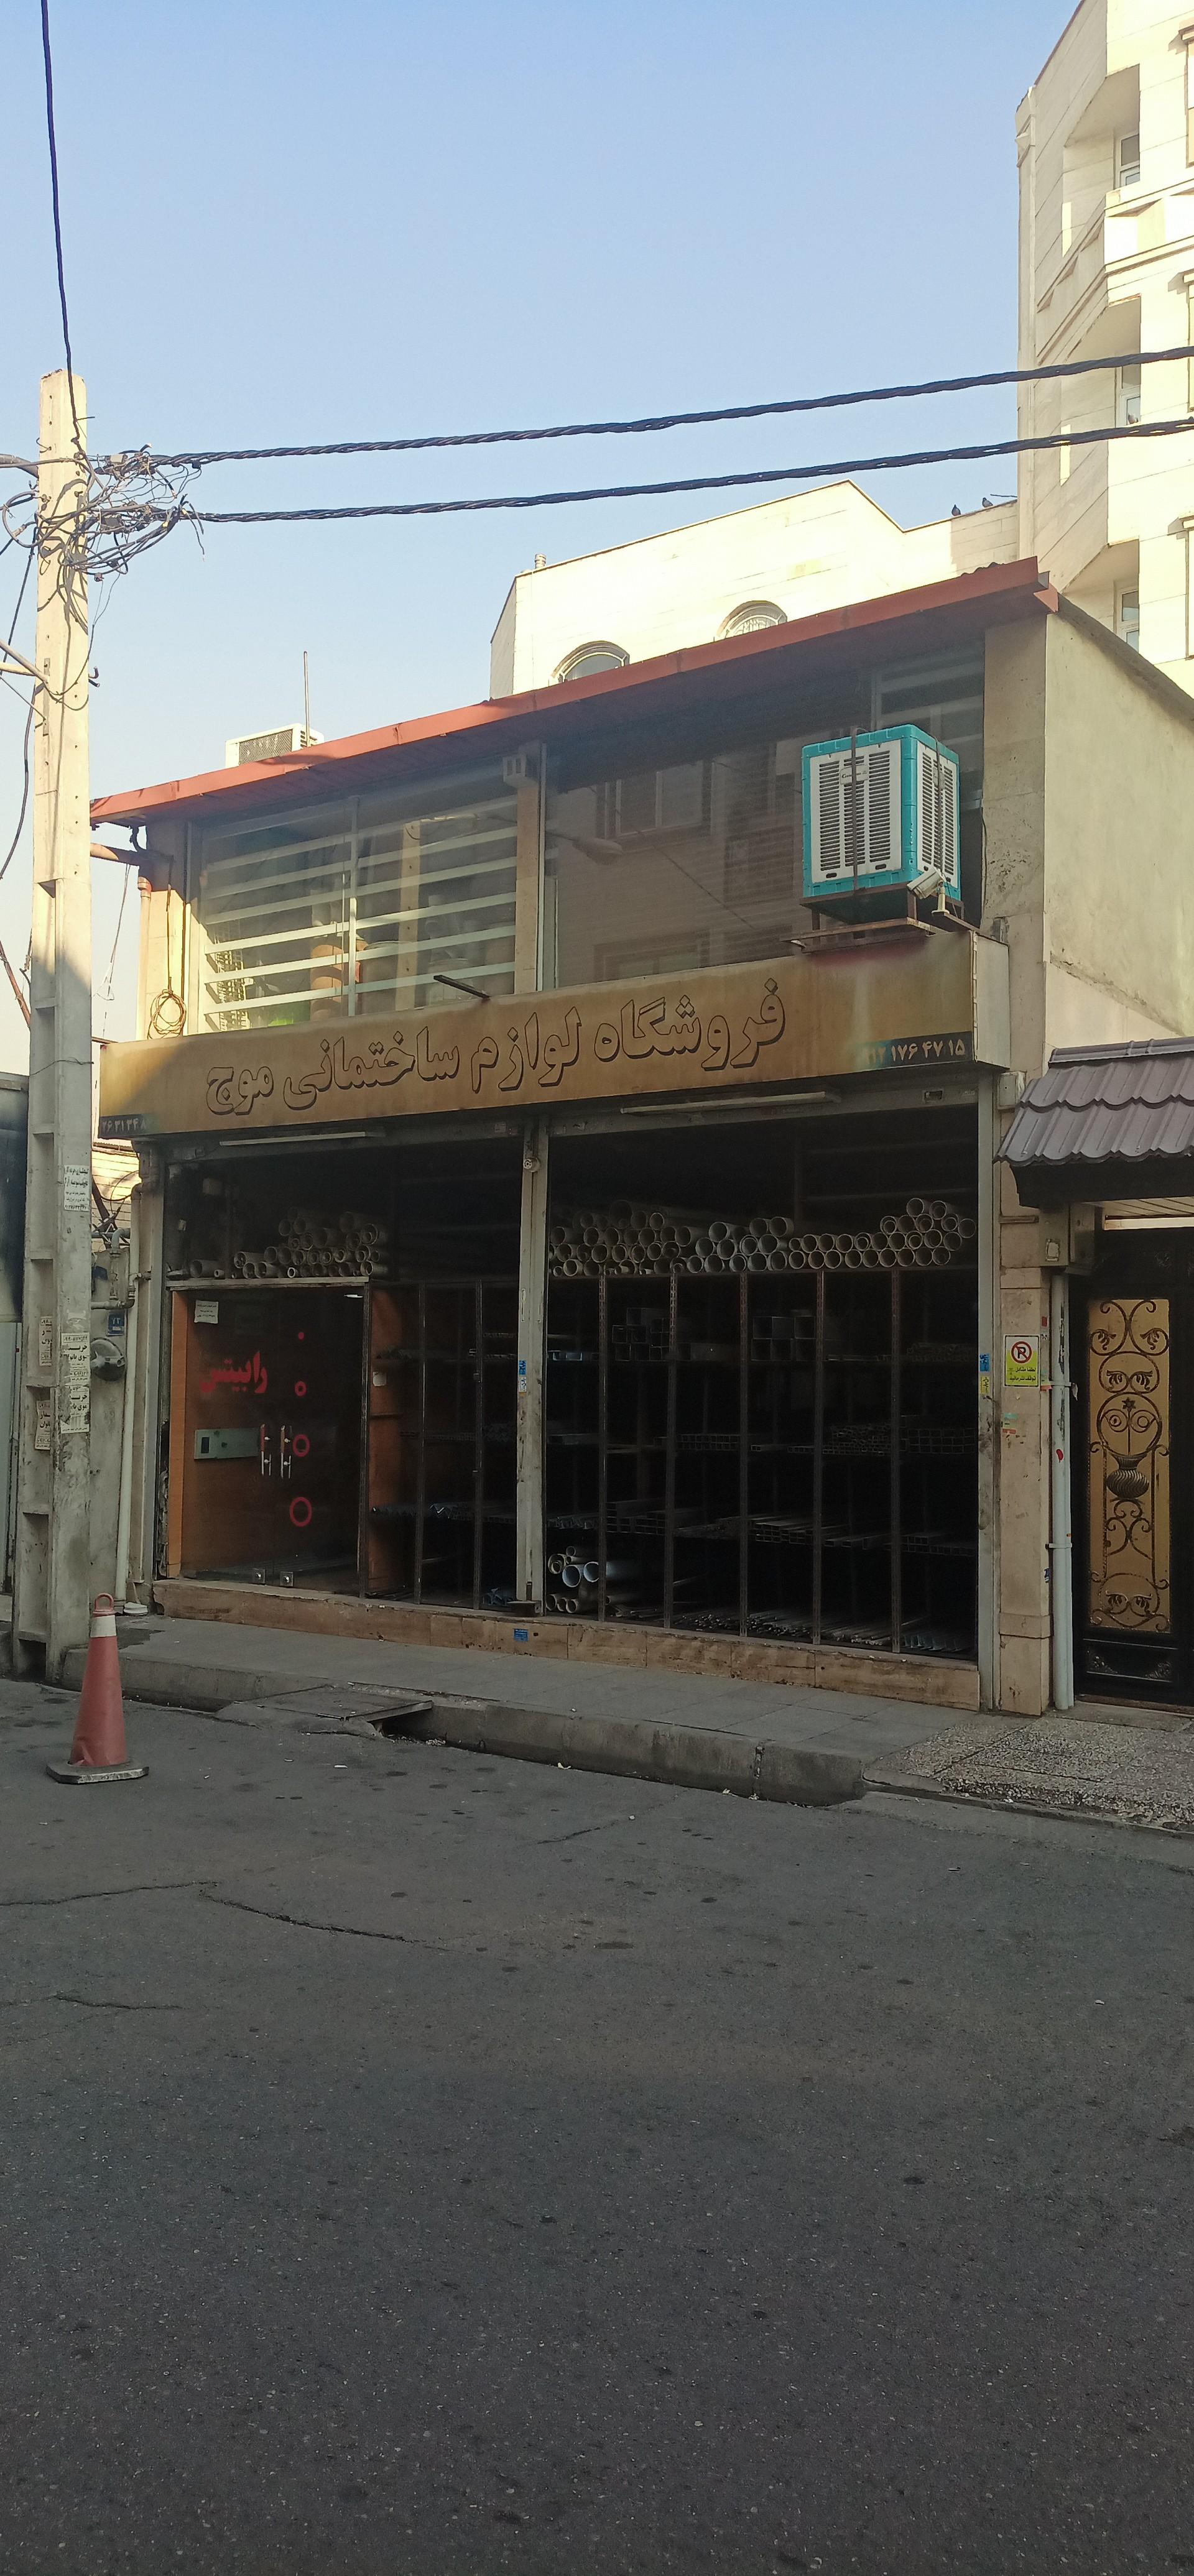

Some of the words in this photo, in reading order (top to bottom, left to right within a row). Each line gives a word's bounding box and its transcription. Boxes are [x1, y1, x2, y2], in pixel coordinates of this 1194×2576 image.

[471, 1006, 582, 1093] لوازم
[594, 978, 786, 1071] فروشگاه
[891, 1043, 919, 1062] ۱۷۶
[922, 1041, 944, 1058] ۴۷
[948, 1039, 966, 1056] ۱۵
[206, 1065, 274, 1116] موج
[283, 1026, 461, 1110] ساختمانی
[199, 1351, 268, 1393] رابیتس
